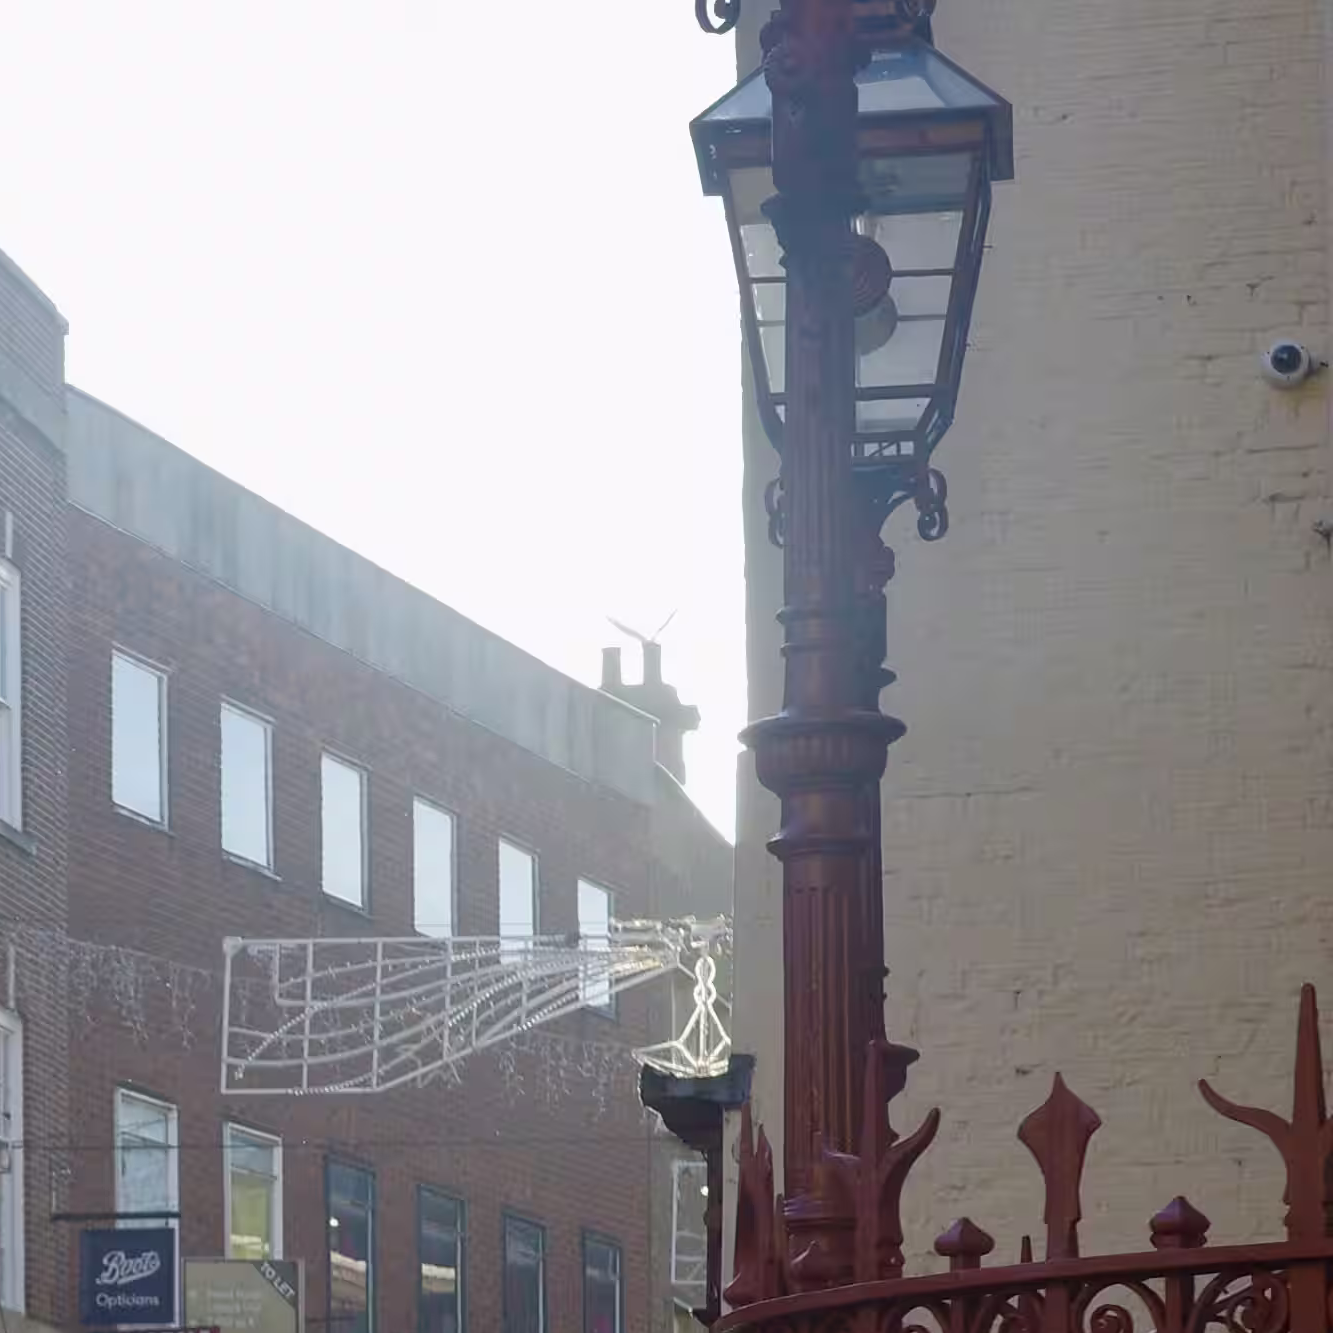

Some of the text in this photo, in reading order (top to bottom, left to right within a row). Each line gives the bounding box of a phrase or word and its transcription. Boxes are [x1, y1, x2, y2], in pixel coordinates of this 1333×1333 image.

[95, 1250, 161, 1285] Boots
[261, 1261, 296, 1298] TO LET
[95, 1292, 160, 1310] Opticians
